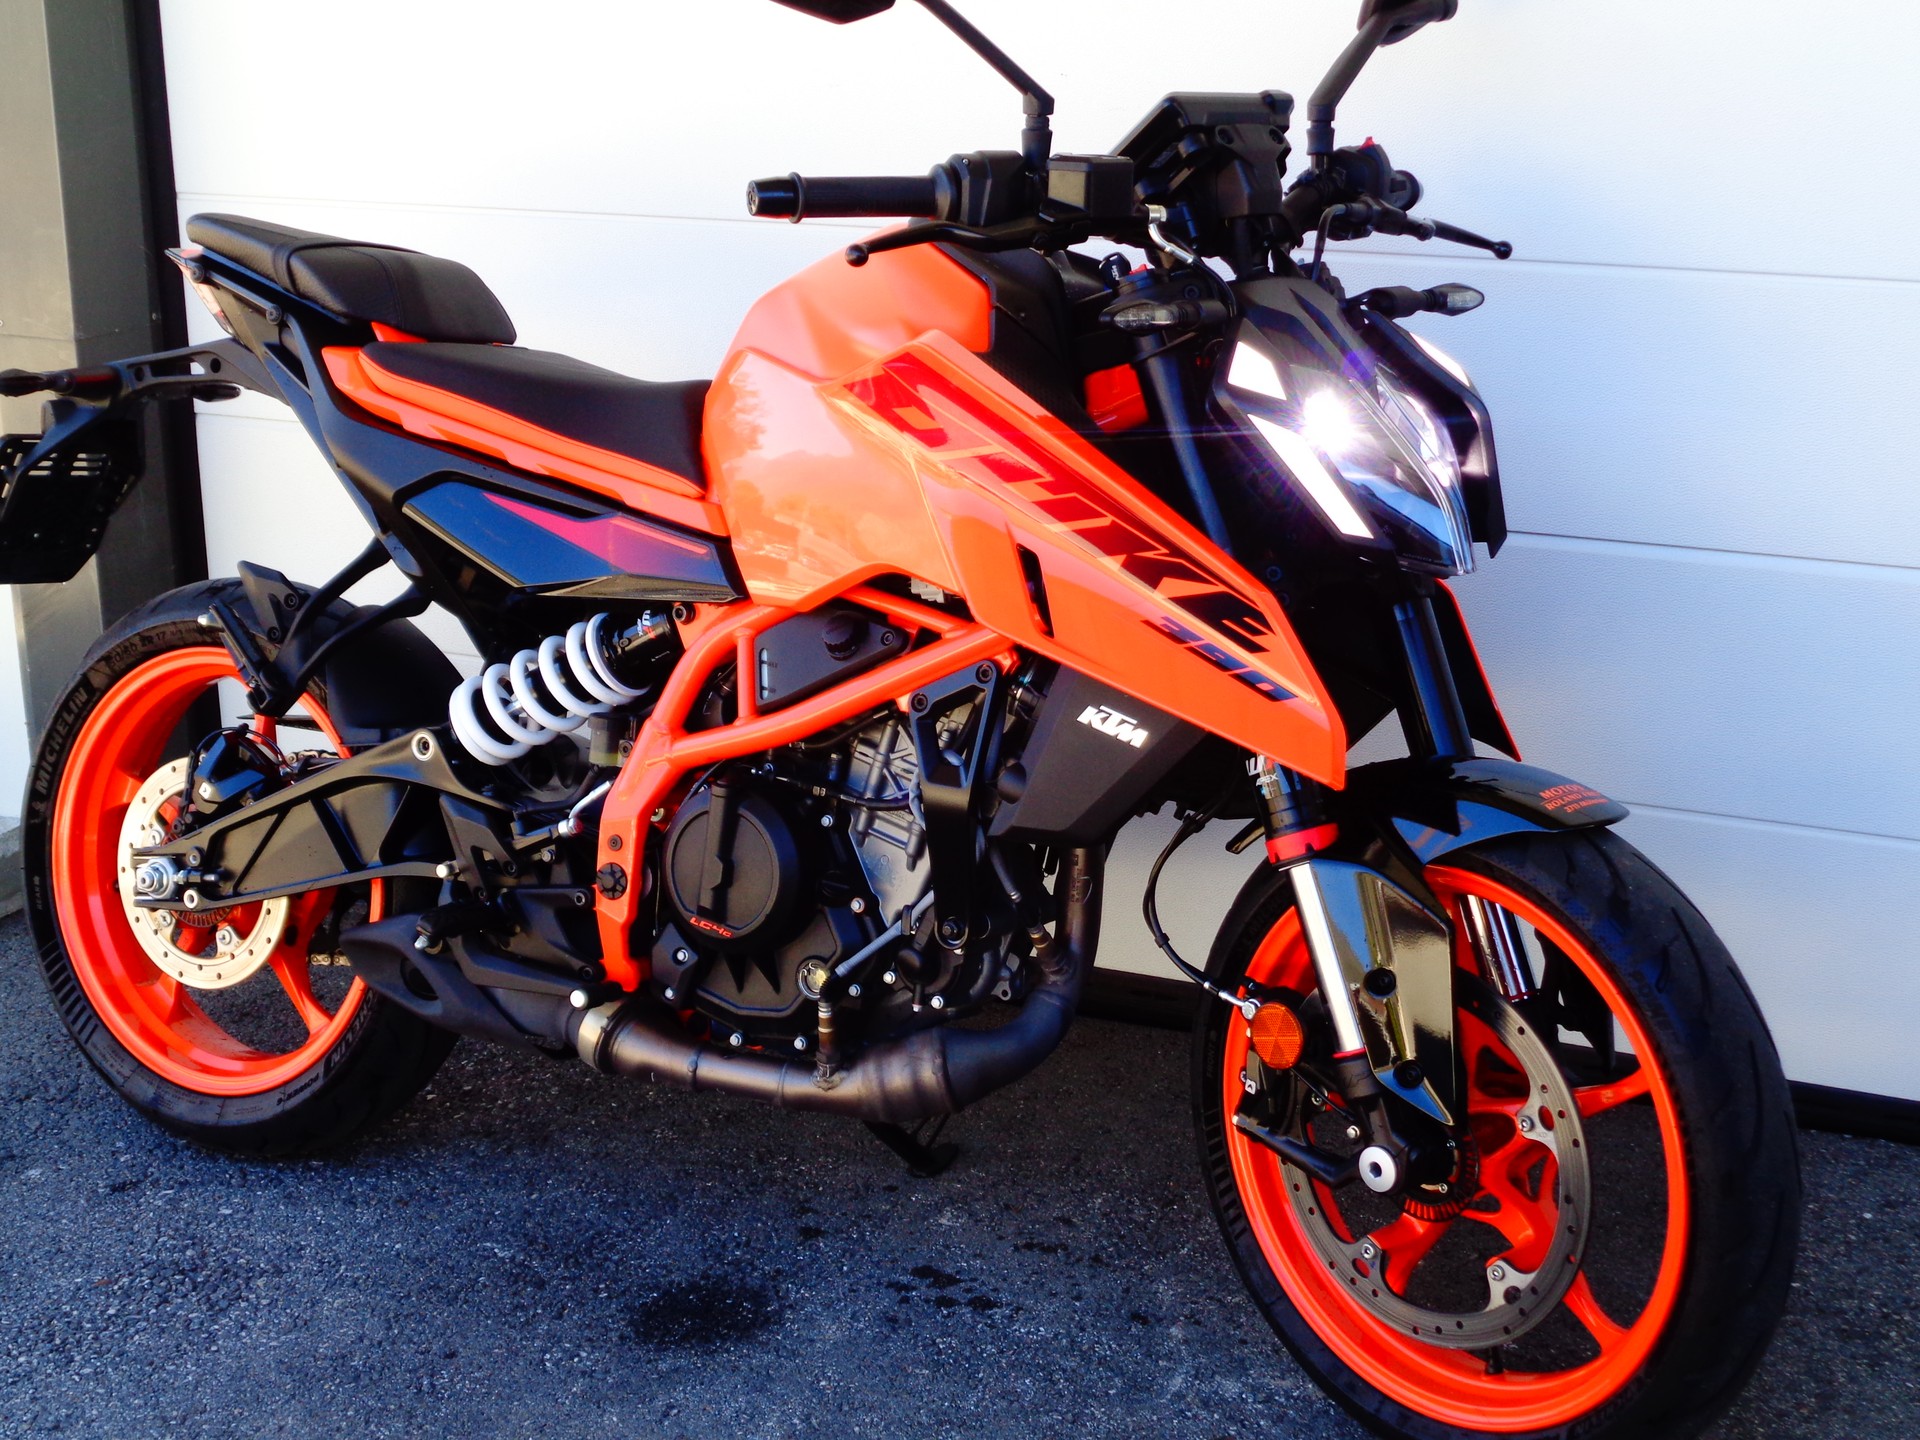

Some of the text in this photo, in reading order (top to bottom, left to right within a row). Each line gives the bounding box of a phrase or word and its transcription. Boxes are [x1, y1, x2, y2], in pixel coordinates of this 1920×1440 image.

[842, 353, 1276, 653] DUKE
[157, 631, 166, 641] 17
[1140, 617, 1298, 702] 390
[34, 686, 89, 795] MICHELIN
[1076, 705, 1149, 748] KTM
[1255, 772, 1279, 787] APEX
[1544, 793, 1582, 811] ROLAND
[331, 989, 375, 1068] CHELIN
